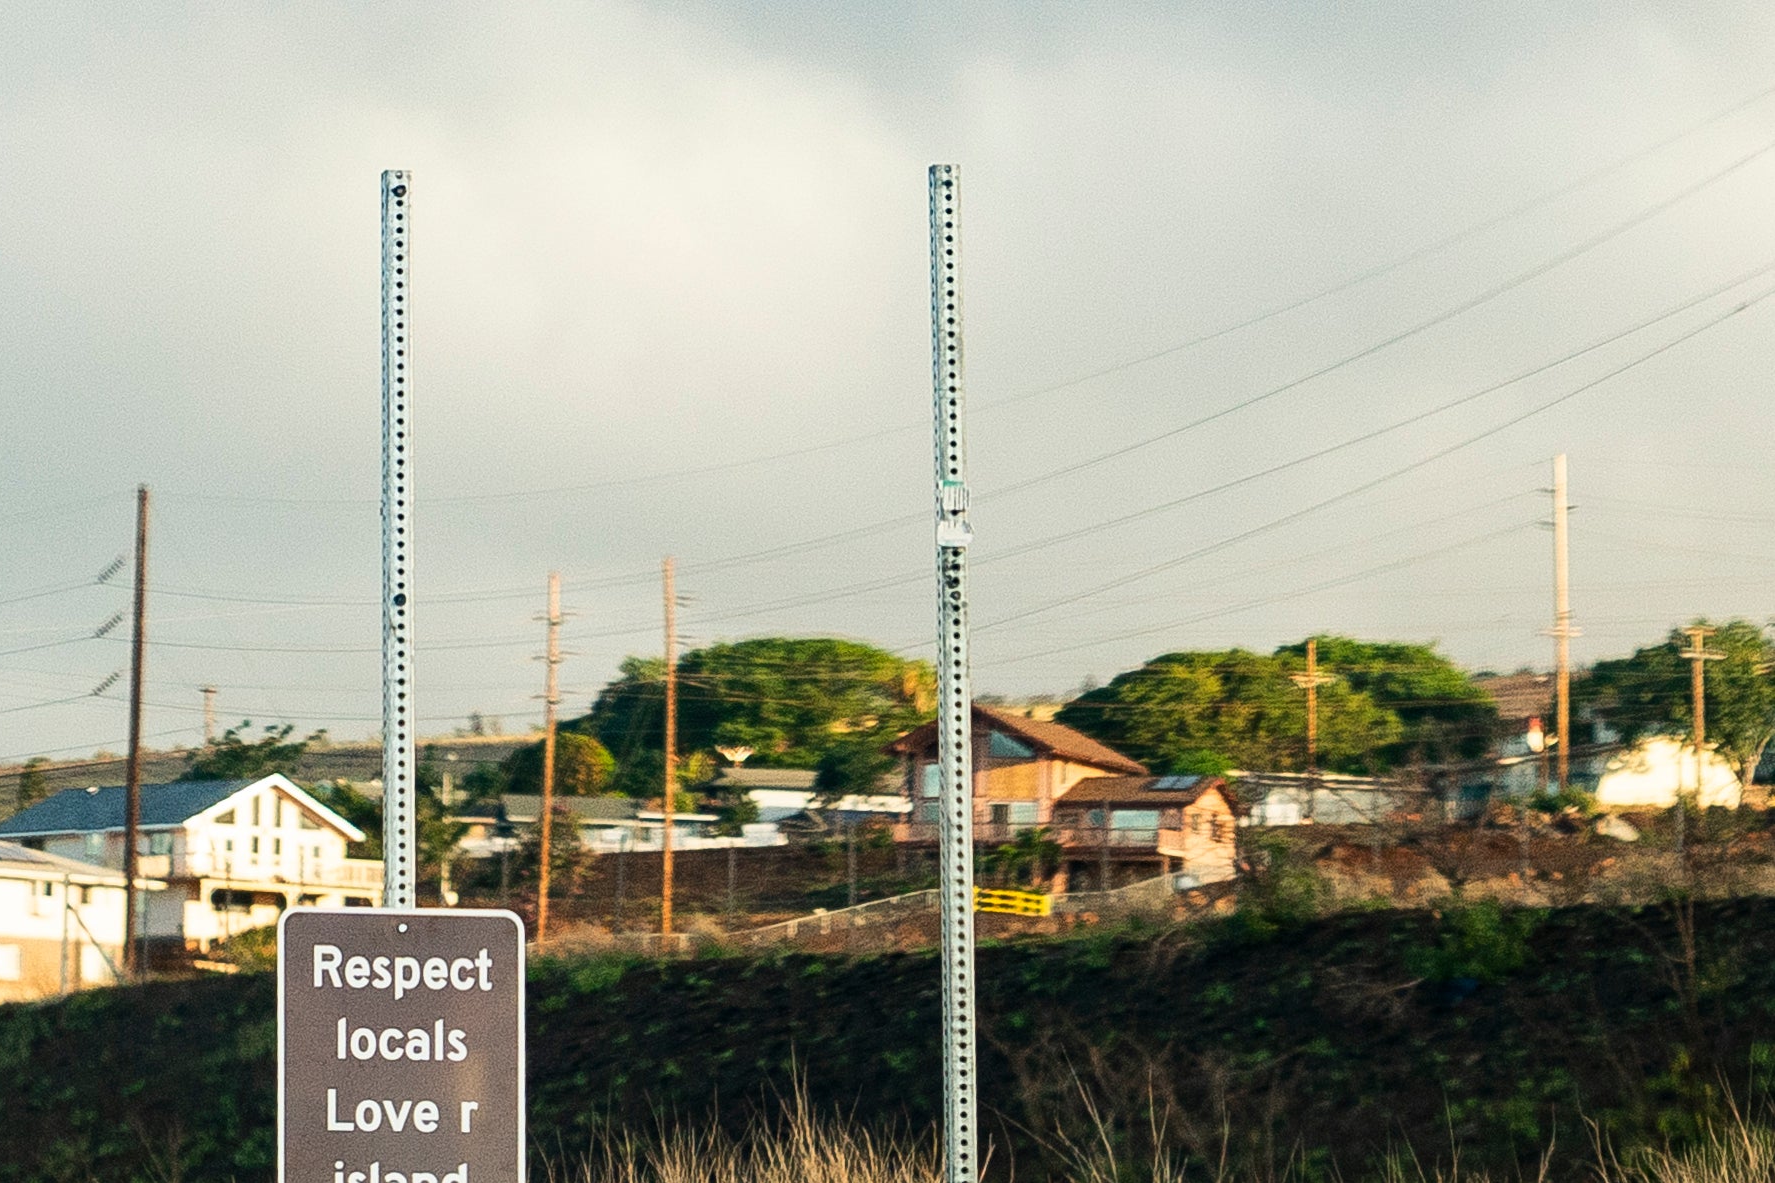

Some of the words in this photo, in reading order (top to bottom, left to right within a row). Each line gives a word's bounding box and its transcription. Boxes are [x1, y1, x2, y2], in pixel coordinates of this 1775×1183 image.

[313, 944, 493, 1000] Respect
[337, 1017, 468, 1061] locals
[327, 1088, 439, 1132] Love
[461, 1101, 478, 1133] r
